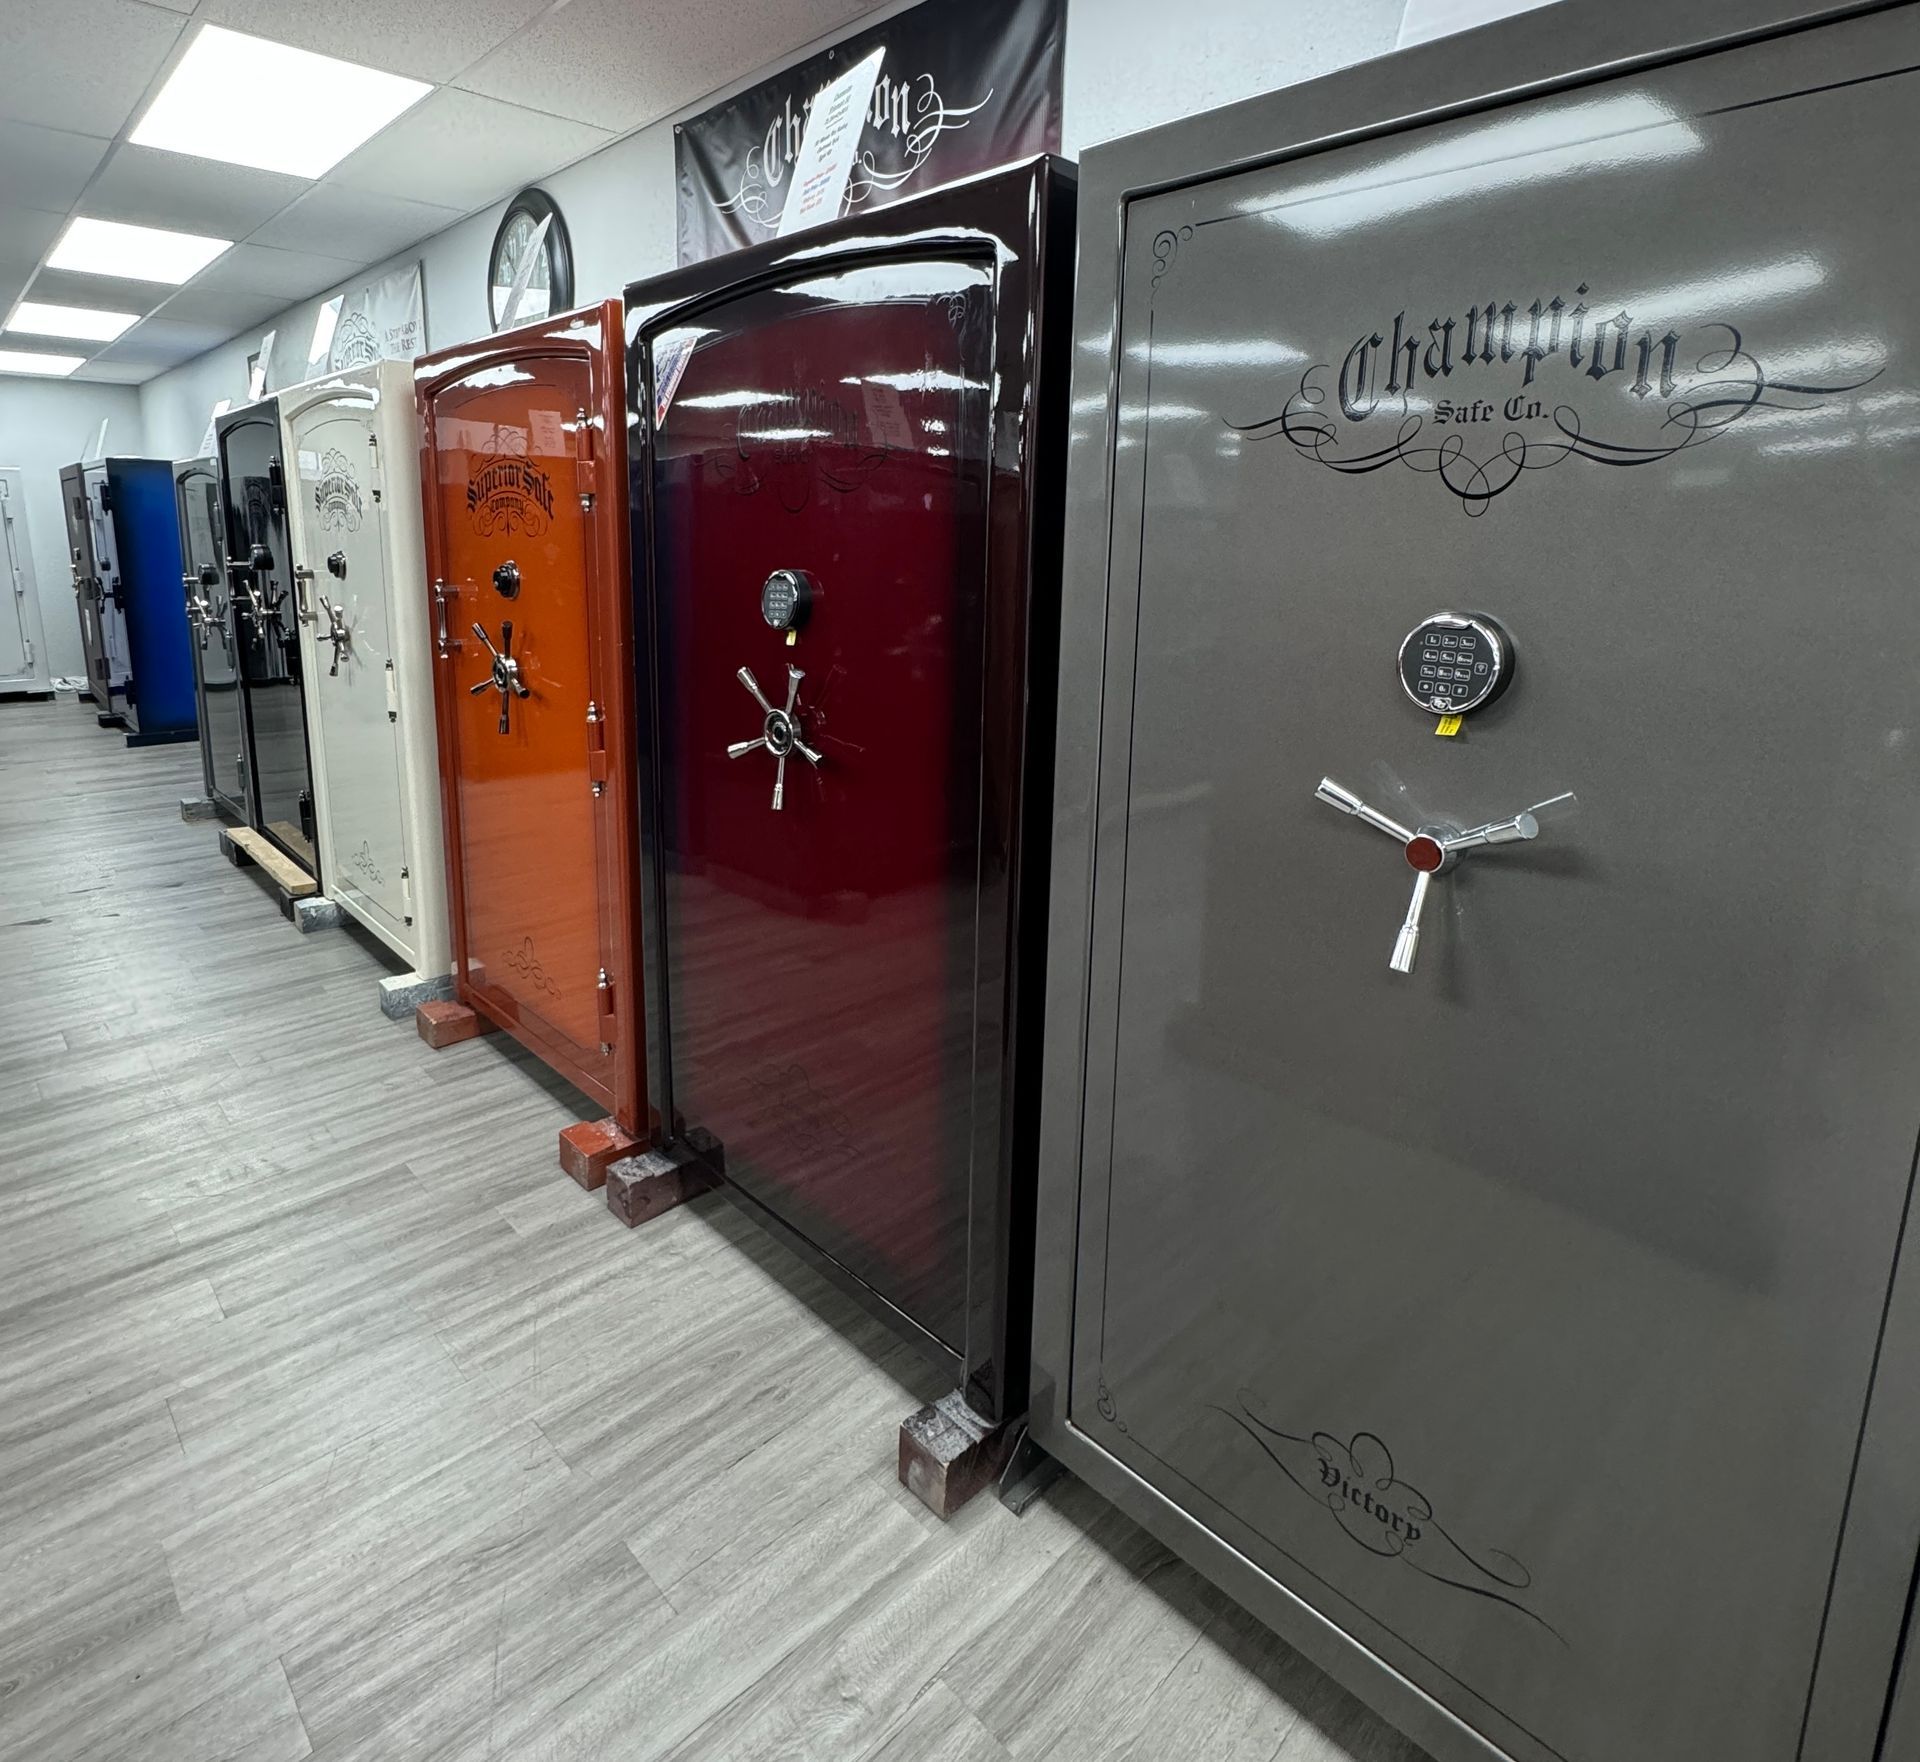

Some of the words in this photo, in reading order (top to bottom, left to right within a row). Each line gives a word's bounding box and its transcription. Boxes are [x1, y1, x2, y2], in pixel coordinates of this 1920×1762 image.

[1338, 281, 1681, 423] Champion
[1433, 397, 1496, 425] Safe
[1502, 395, 1549, 421] Co.
[467, 463, 521, 513] Superior
[521, 461, 554, 520] Safe
[1317, 1458, 1421, 1547] Victory
